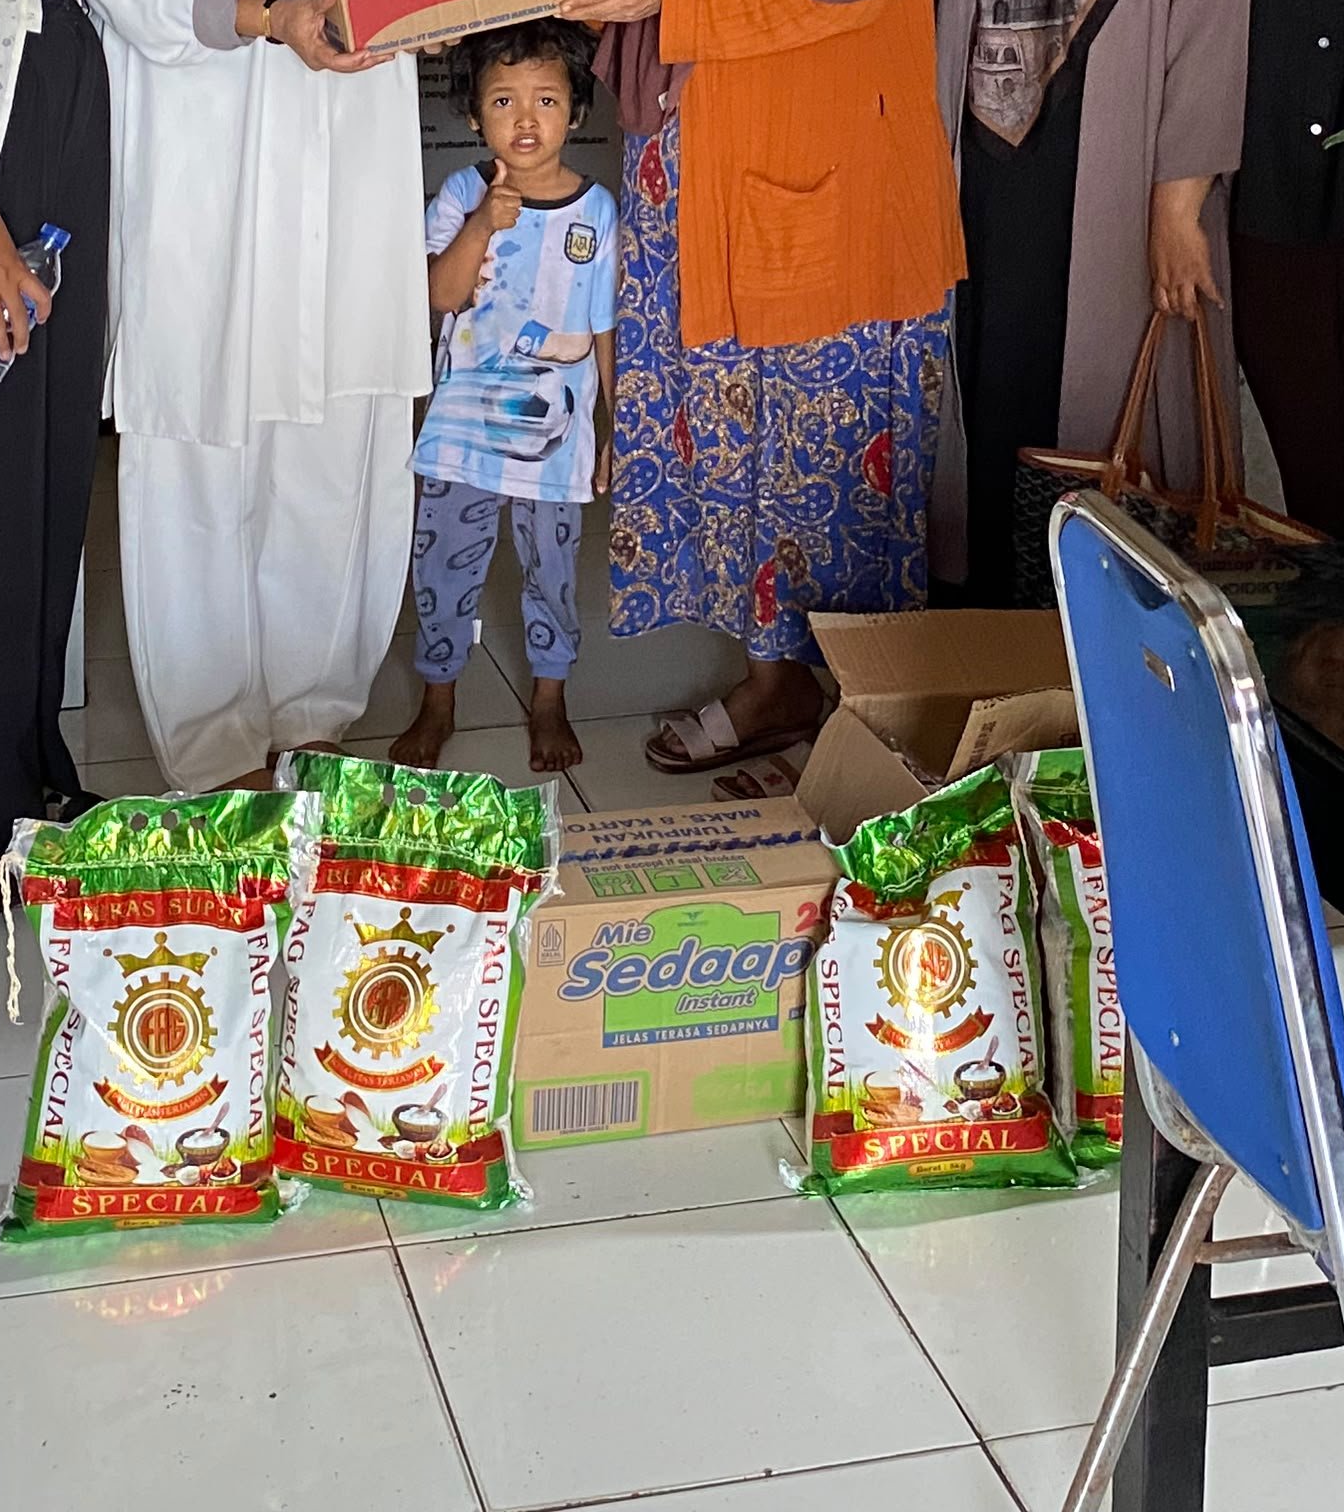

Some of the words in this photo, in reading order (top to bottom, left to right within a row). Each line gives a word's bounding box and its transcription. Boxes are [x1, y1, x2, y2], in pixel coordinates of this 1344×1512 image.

[564, 817, 653, 834] KARTO
[592, 824, 737, 844] TUMPUKAN
[996, 873, 1017, 935] FAG
[481, 919, 508, 986] FAG
[595, 923, 652, 946] Mie
[558, 937, 814, 1000] Sedaap
[677, 989, 757, 1012] Instant
[1003, 947, 1039, 1085] SPECIAL
[612, 1032, 649, 1045] JELAS
[655, 1025, 700, 1041] TERASA
[706, 1020, 769, 1035] SEDAPNYA
[820, 958, 847, 1098] SPECIAL
[248, 1007, 266, 1149] SPECIAL
[469, 998, 500, 1135] SPECIAL
[864, 1129, 1018, 1162] SPECIAL
[302, 1152, 453, 1190] SPECIAL
[71, 1190, 234, 1216] SPECIAL
